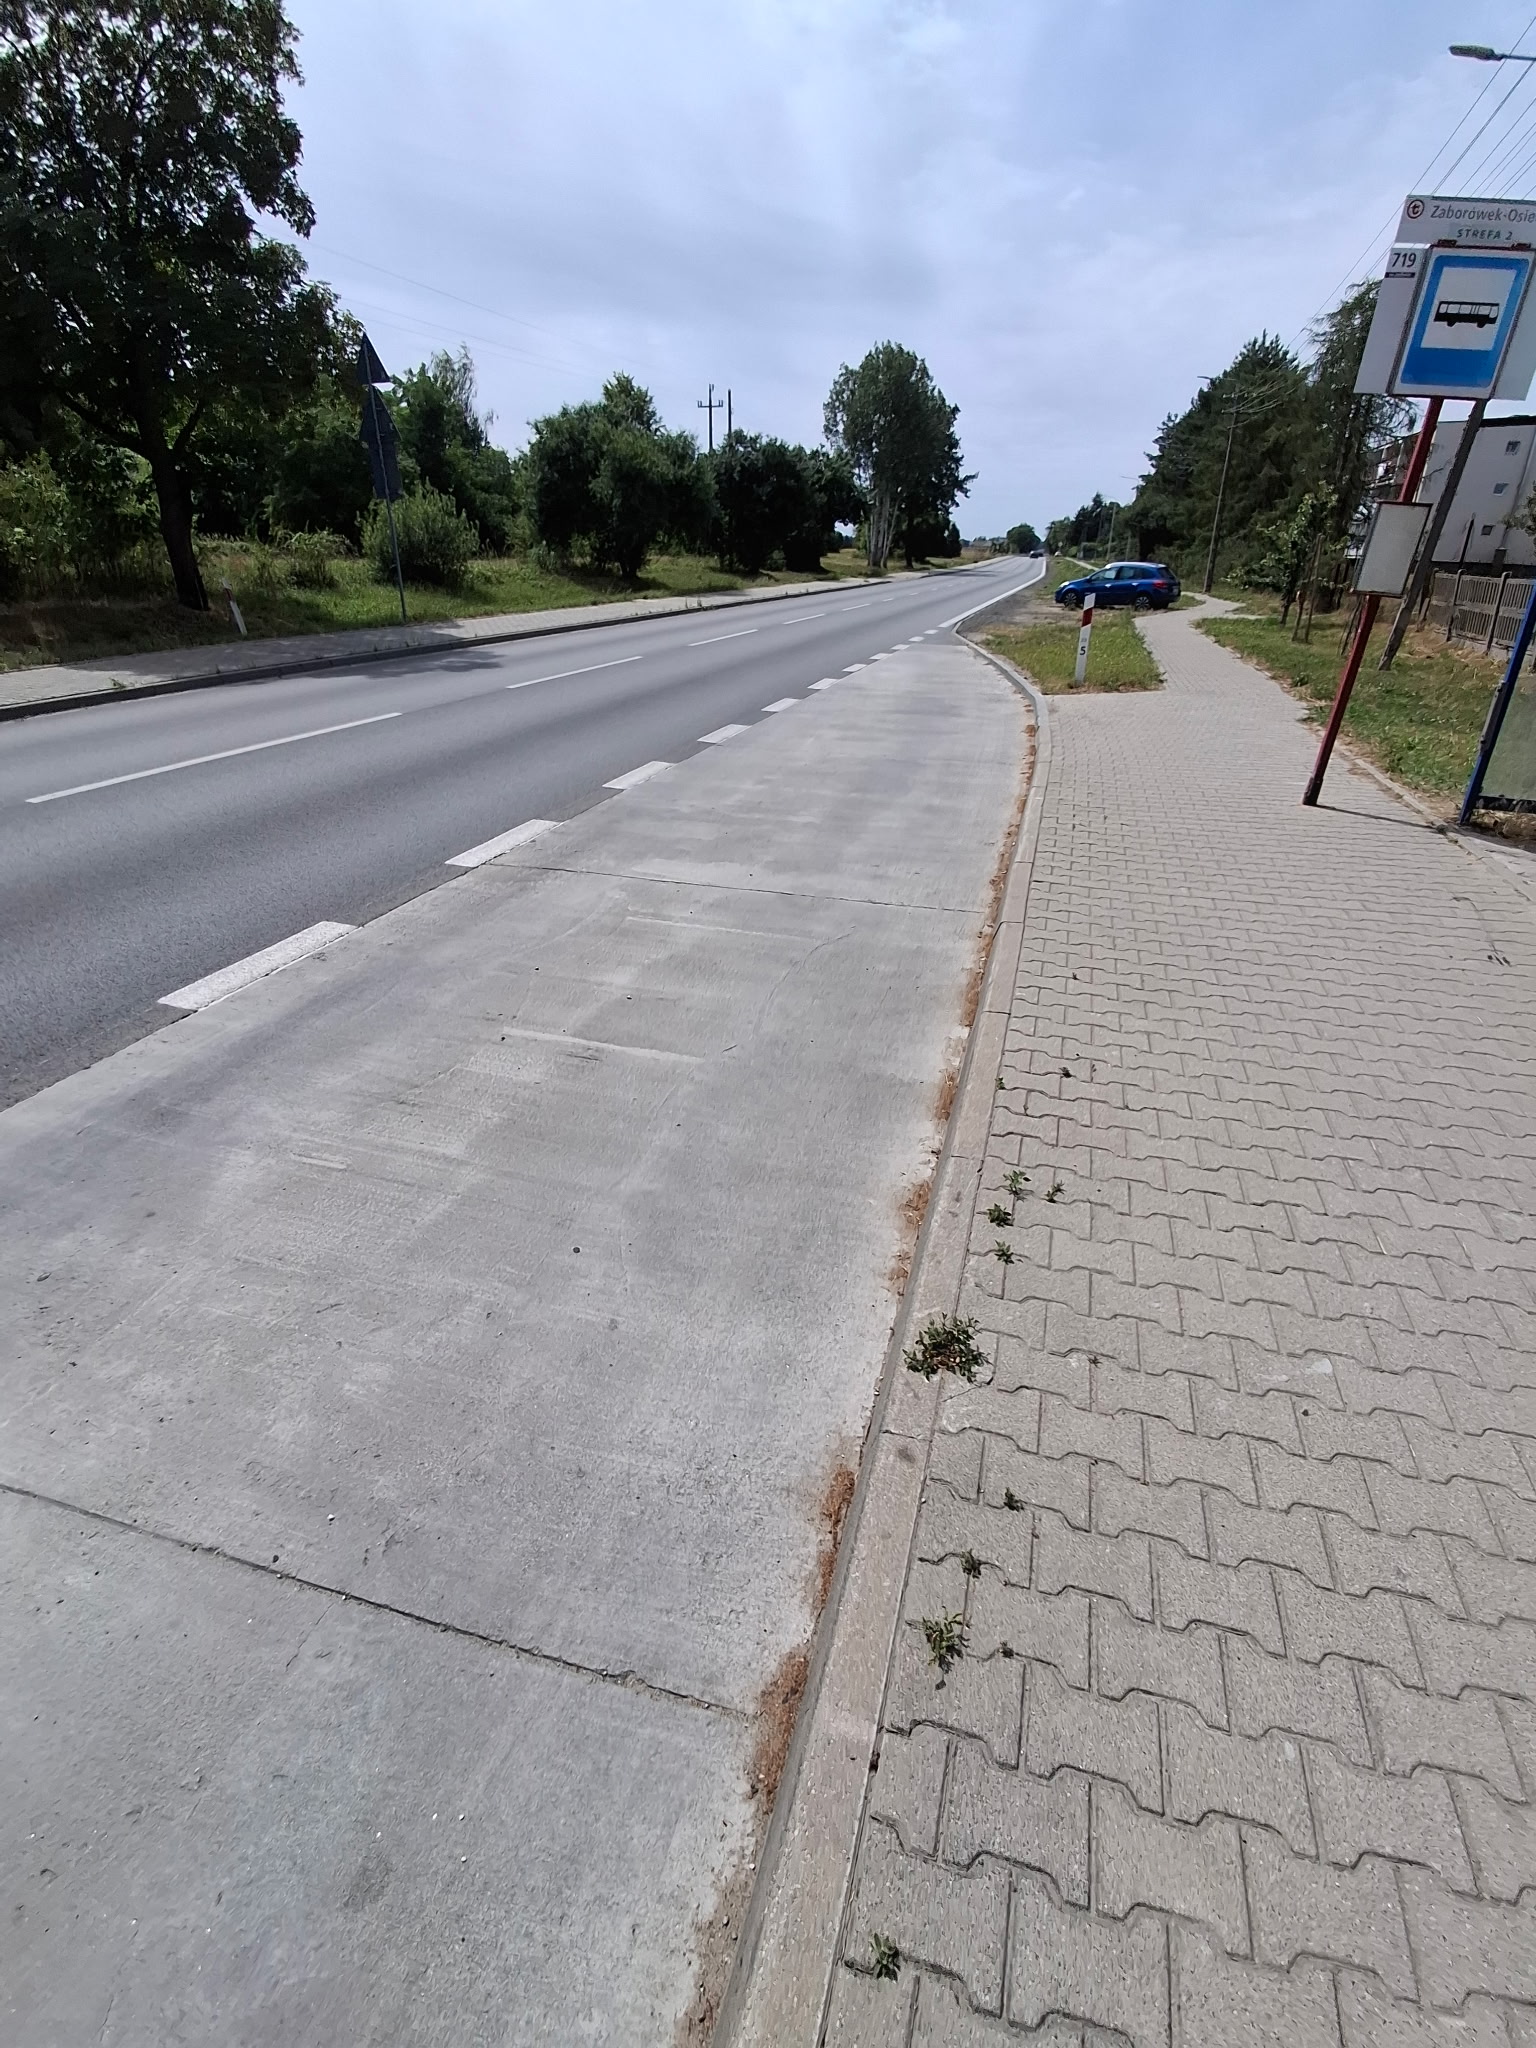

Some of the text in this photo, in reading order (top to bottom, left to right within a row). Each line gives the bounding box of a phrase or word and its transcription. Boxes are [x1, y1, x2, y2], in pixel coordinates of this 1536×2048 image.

[1430, 205, 1536, 223] Zaborówek-Osie
[1457, 228, 1513, 240] STREFA 2
[1391, 252, 1417, 267] 719
[1079, 645, 1086, 656] 5
